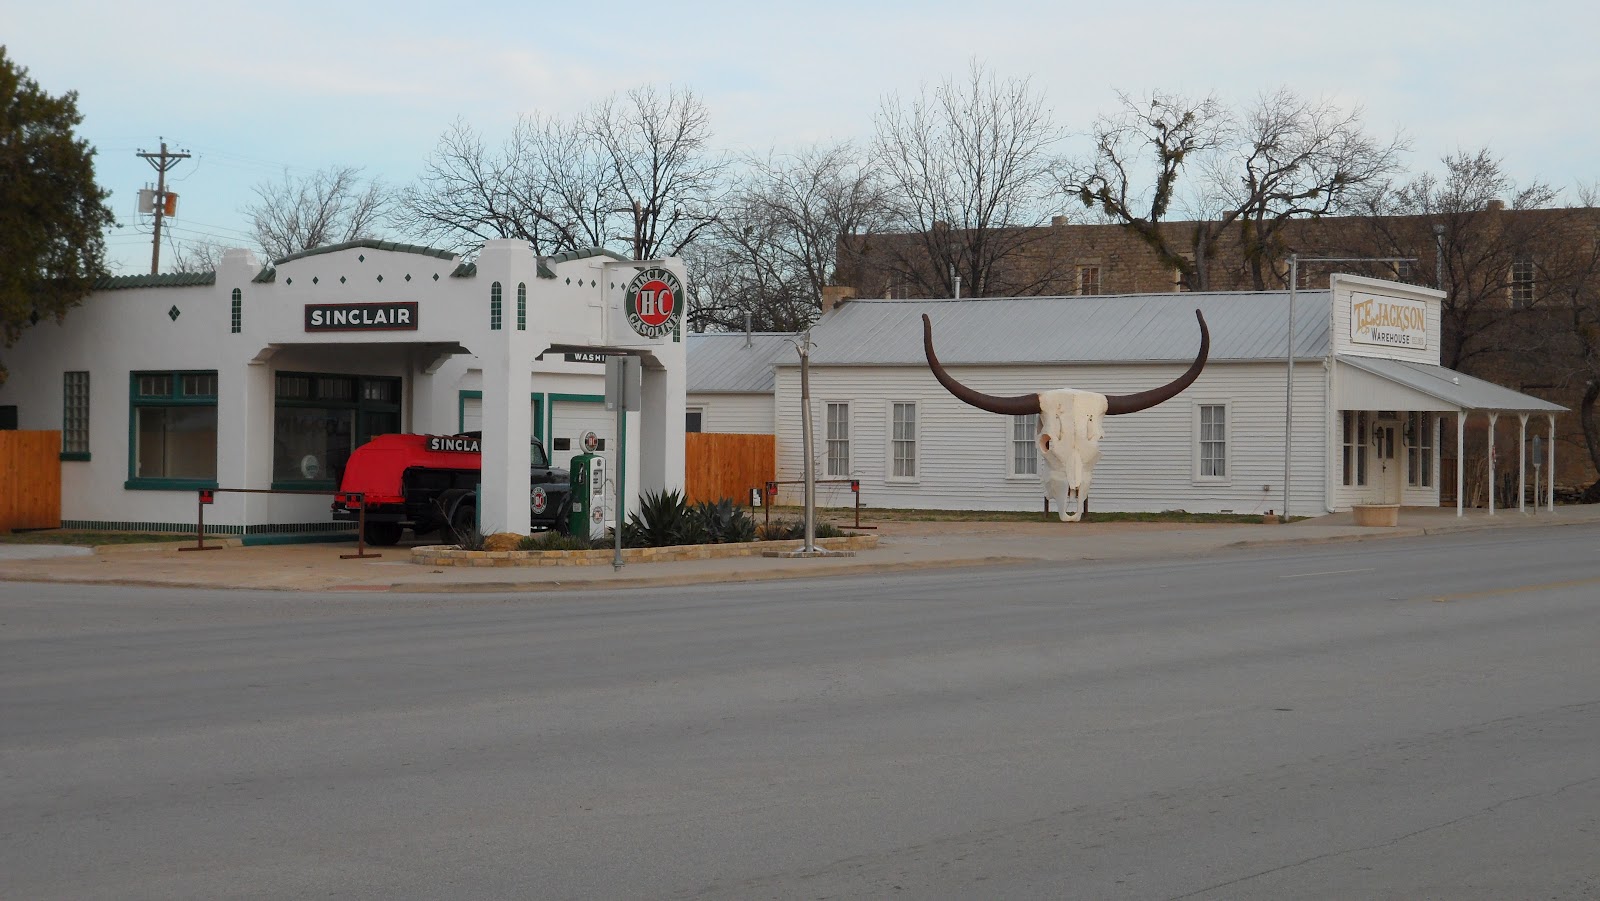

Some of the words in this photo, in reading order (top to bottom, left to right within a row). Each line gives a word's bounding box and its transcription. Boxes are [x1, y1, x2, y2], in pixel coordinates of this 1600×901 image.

[630, 269, 680, 295] SINCLAIR
[311, 308, 410, 326] SINCLAIR
[629, 312, 680, 337] GASOLINE
[1375, 303, 1425, 332] JACKSON
[574, 353, 604, 361] WASHI
[431, 438, 479, 451] SINCLA
